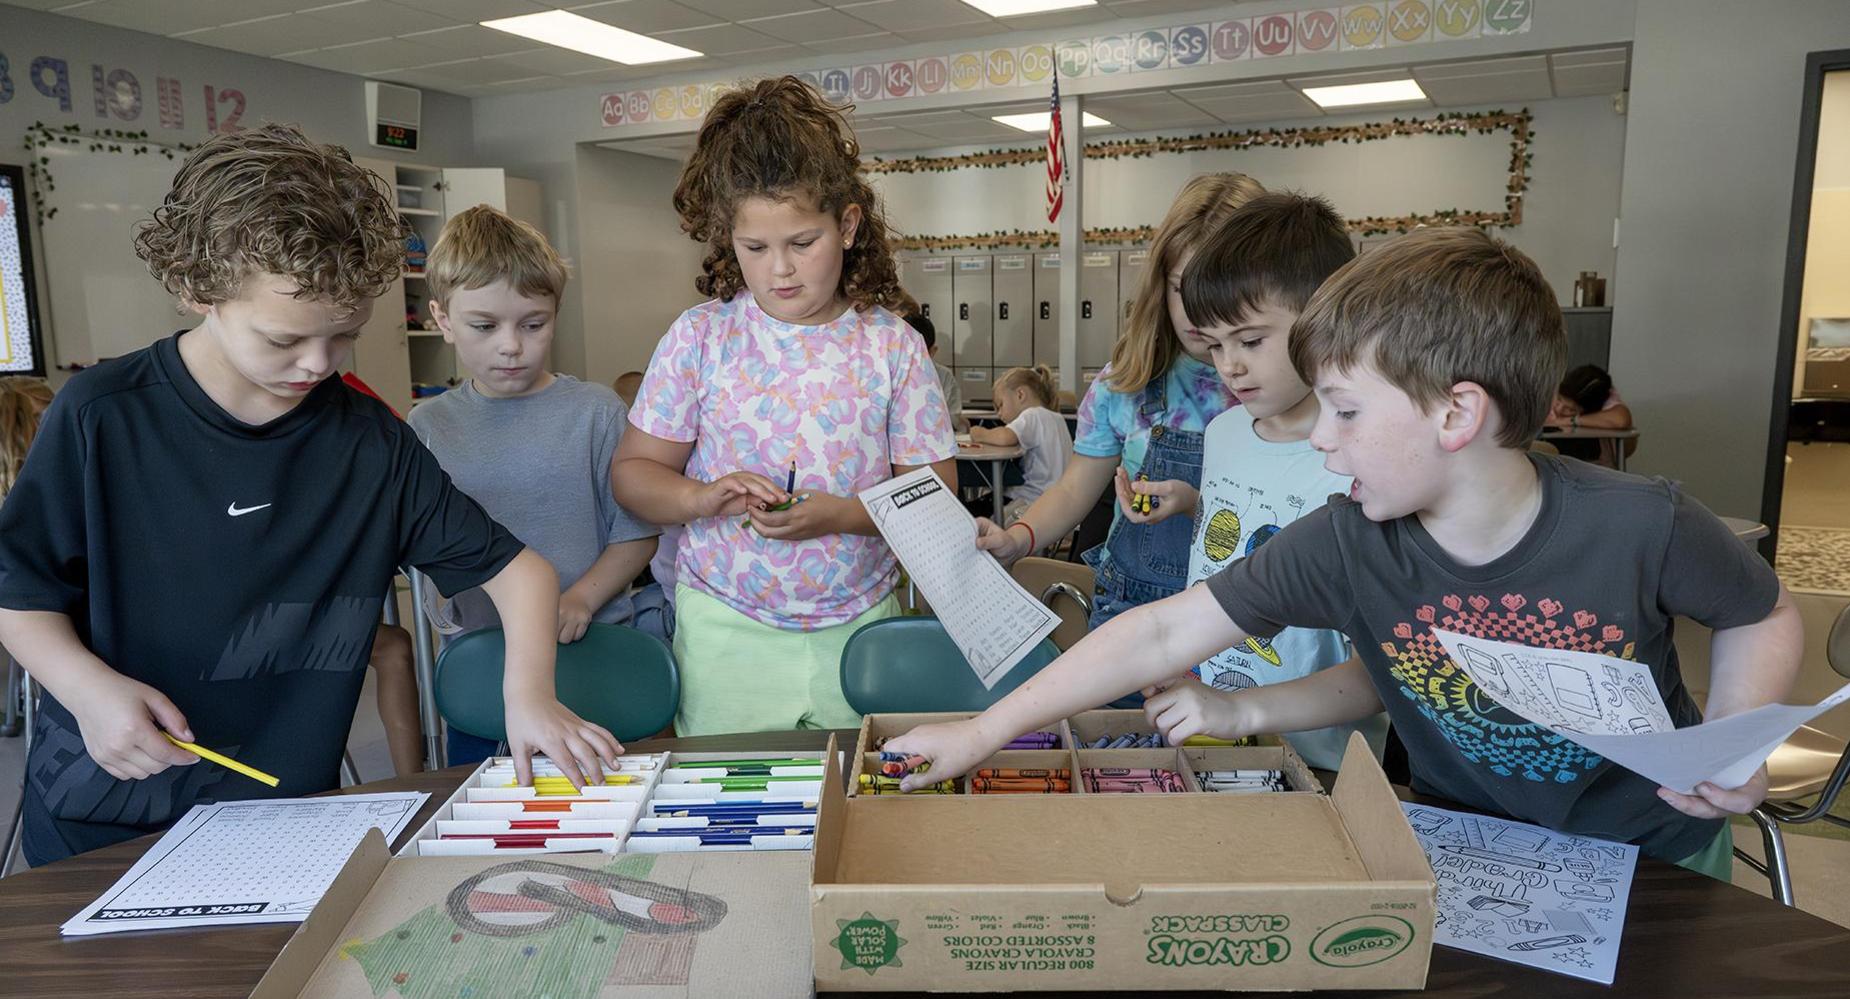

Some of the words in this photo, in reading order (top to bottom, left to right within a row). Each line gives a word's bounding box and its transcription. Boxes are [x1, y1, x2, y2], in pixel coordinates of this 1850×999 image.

[629, 97, 648, 113] Bb
[859, 71, 873, 94] Jj
[888, 69, 911, 88] Kk
[987, 58, 1013, 76] Nn
[1022, 52, 1050, 72] Oo
[1178, 33, 1203, 55] Ss
[1220, 28, 1242, 49] Tt
[1259, 22, 1289, 45] Uu
[1302, 18, 1335, 40] Vv
[1393, 8, 1427, 31] Xx
[1442, 2, 1475, 29] Yy
[30, 56, 72, 112] 9
[92, 64, 142, 121] 10
[204, 84, 246, 135] 12
[101, 908, 173, 918] SCHOOL
[178, 907, 204, 917] TO
[926, 914, 953, 922] Yellow
[1025, 914, 1044, 922] Blue
[927, 923, 954, 931] Green
[1012, 922, 1044, 930] Orange
[1152, 915, 1290, 933] CLASSPACK
[851, 936, 886, 946] SOLAR
[943, 936, 1003, 947] COLORS
[1006, 935, 1083, 946] ASSORTED
[1087, 935, 1096, 945] 8
[855, 946, 884, 955] WITH
[1147, 935, 1291, 966] CRAYONS
[1333, 937, 1395, 956] Crayola
[950, 948, 1021, 959] CRAYONS
[1025, 947, 1095, 958] CRAYOLA
[855, 955, 884, 965] MADE
[965, 960, 996, 971] SIZE
[998, 960, 1066, 971] REGULAR
[1069, 960, 1094, 969] 800
